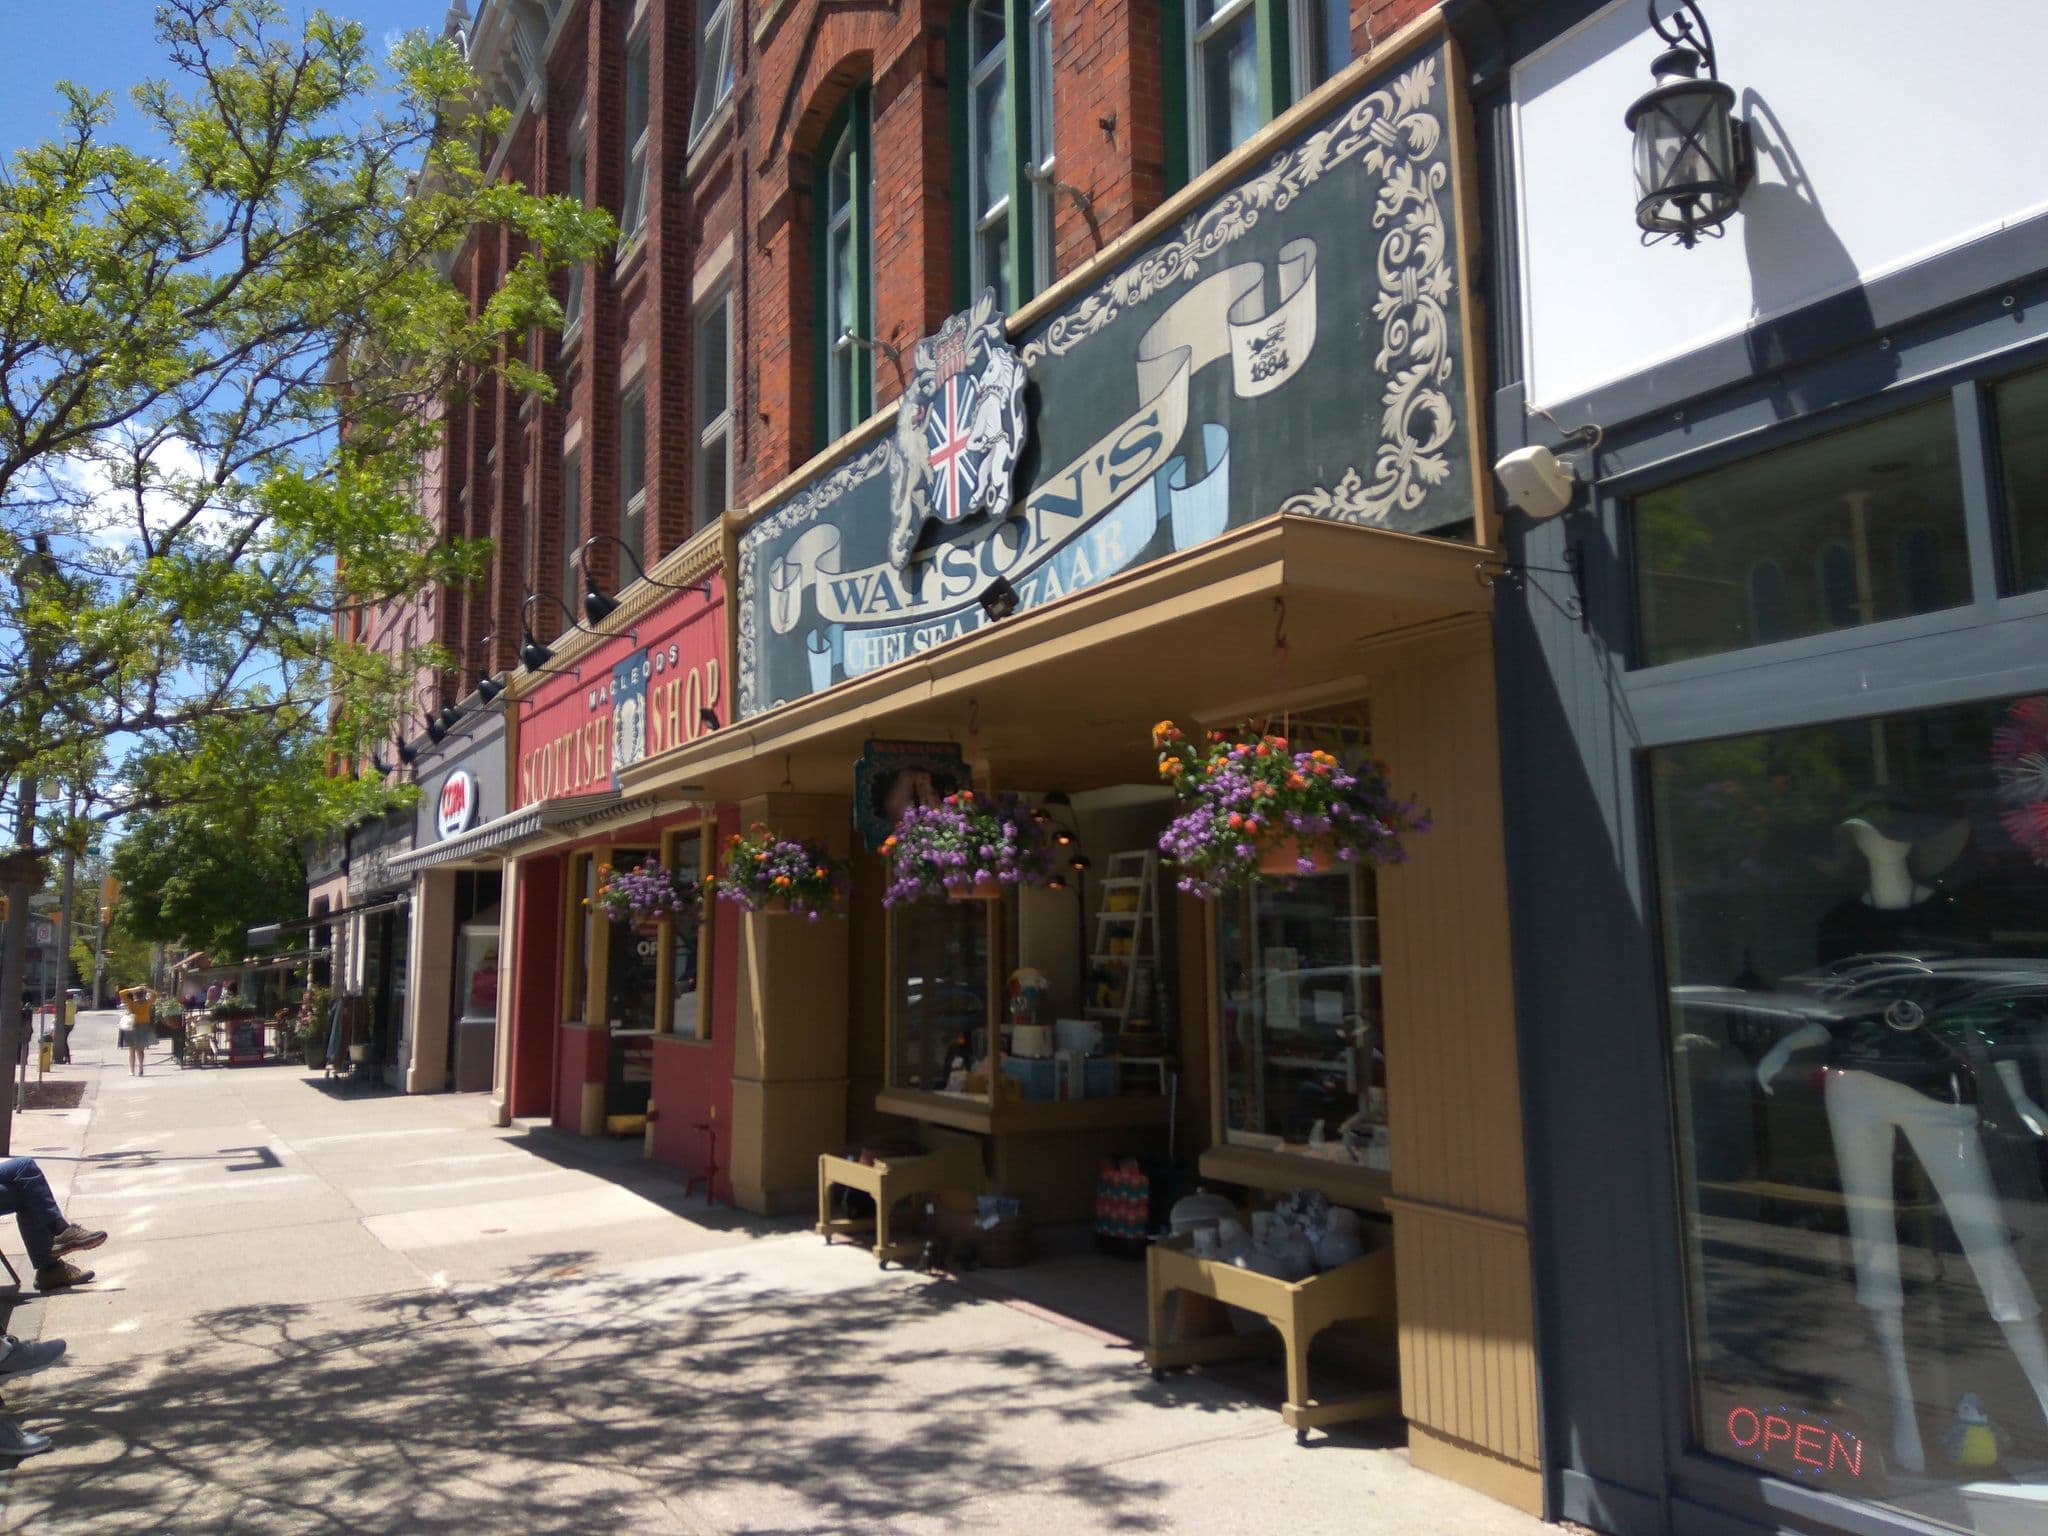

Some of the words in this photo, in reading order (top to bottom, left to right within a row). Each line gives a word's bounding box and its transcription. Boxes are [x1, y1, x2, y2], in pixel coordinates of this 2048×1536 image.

[1250, 350, 1290, 382] 1884
[828, 409, 1163, 615] WATSON'S
[588, 645, 679, 708] MACLEODS
[847, 619, 963, 669] CHELSEA
[522, 716, 609, 804] SCOTTISH
[652, 658, 720, 755] SHOP
[1727, 1407, 1863, 1477] OPEN
